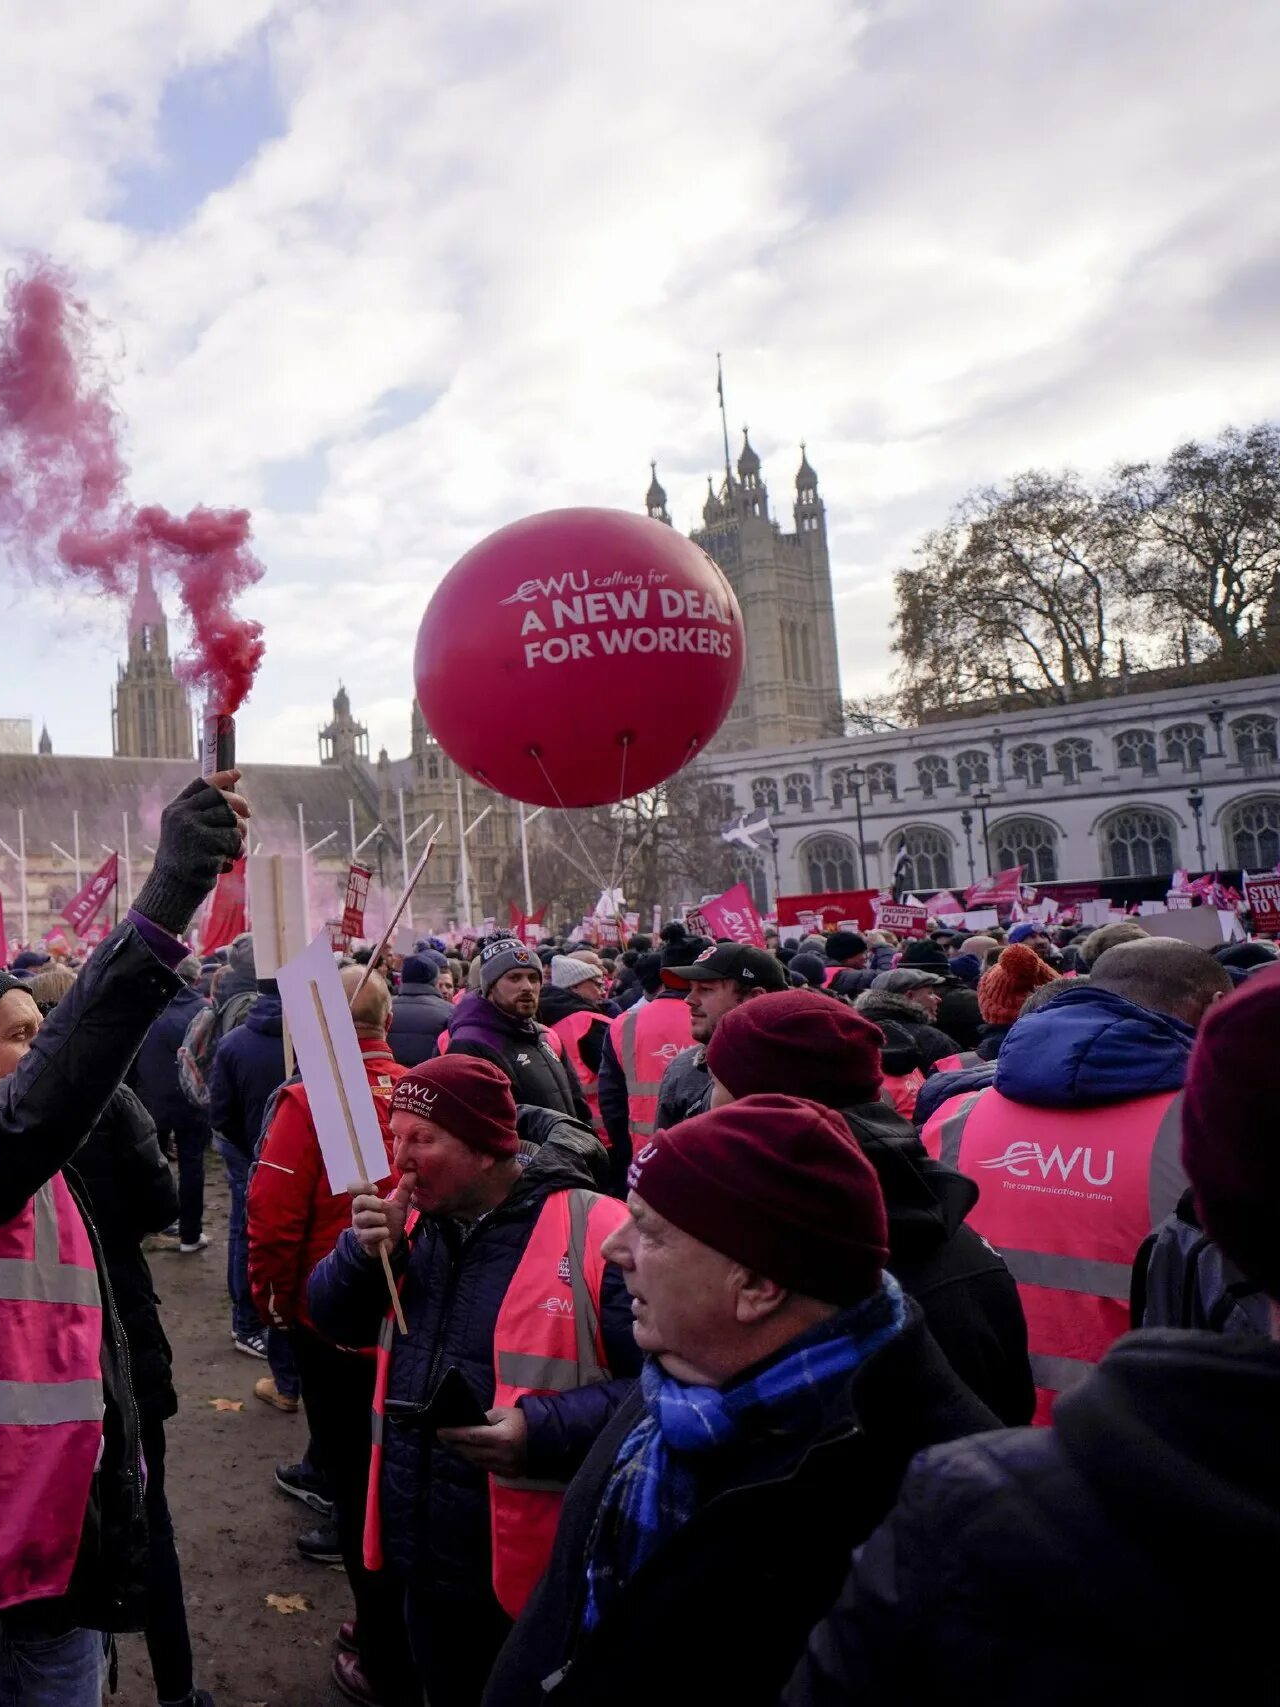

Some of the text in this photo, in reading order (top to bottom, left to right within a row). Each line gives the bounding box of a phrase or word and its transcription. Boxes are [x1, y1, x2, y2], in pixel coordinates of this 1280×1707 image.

[500, 568, 669, 606] CWU calling for
[521, 588, 731, 636] A NEW DEAL
[523, 626, 732, 668] FOR WORKERS
[1251, 899, 1271, 914] TO
[882, 914, 909, 925] OUT!
[483, 942, 517, 960] WEST
[395, 1083, 438, 1102] CWU
[407, 1104, 430, 1118] Branch
[408, 1098, 433, 1111] Central
[976, 1141, 1114, 1185] CWU
[1002, 1180, 1113, 1202] The communications union
[537, 1297, 574, 1313] CW
